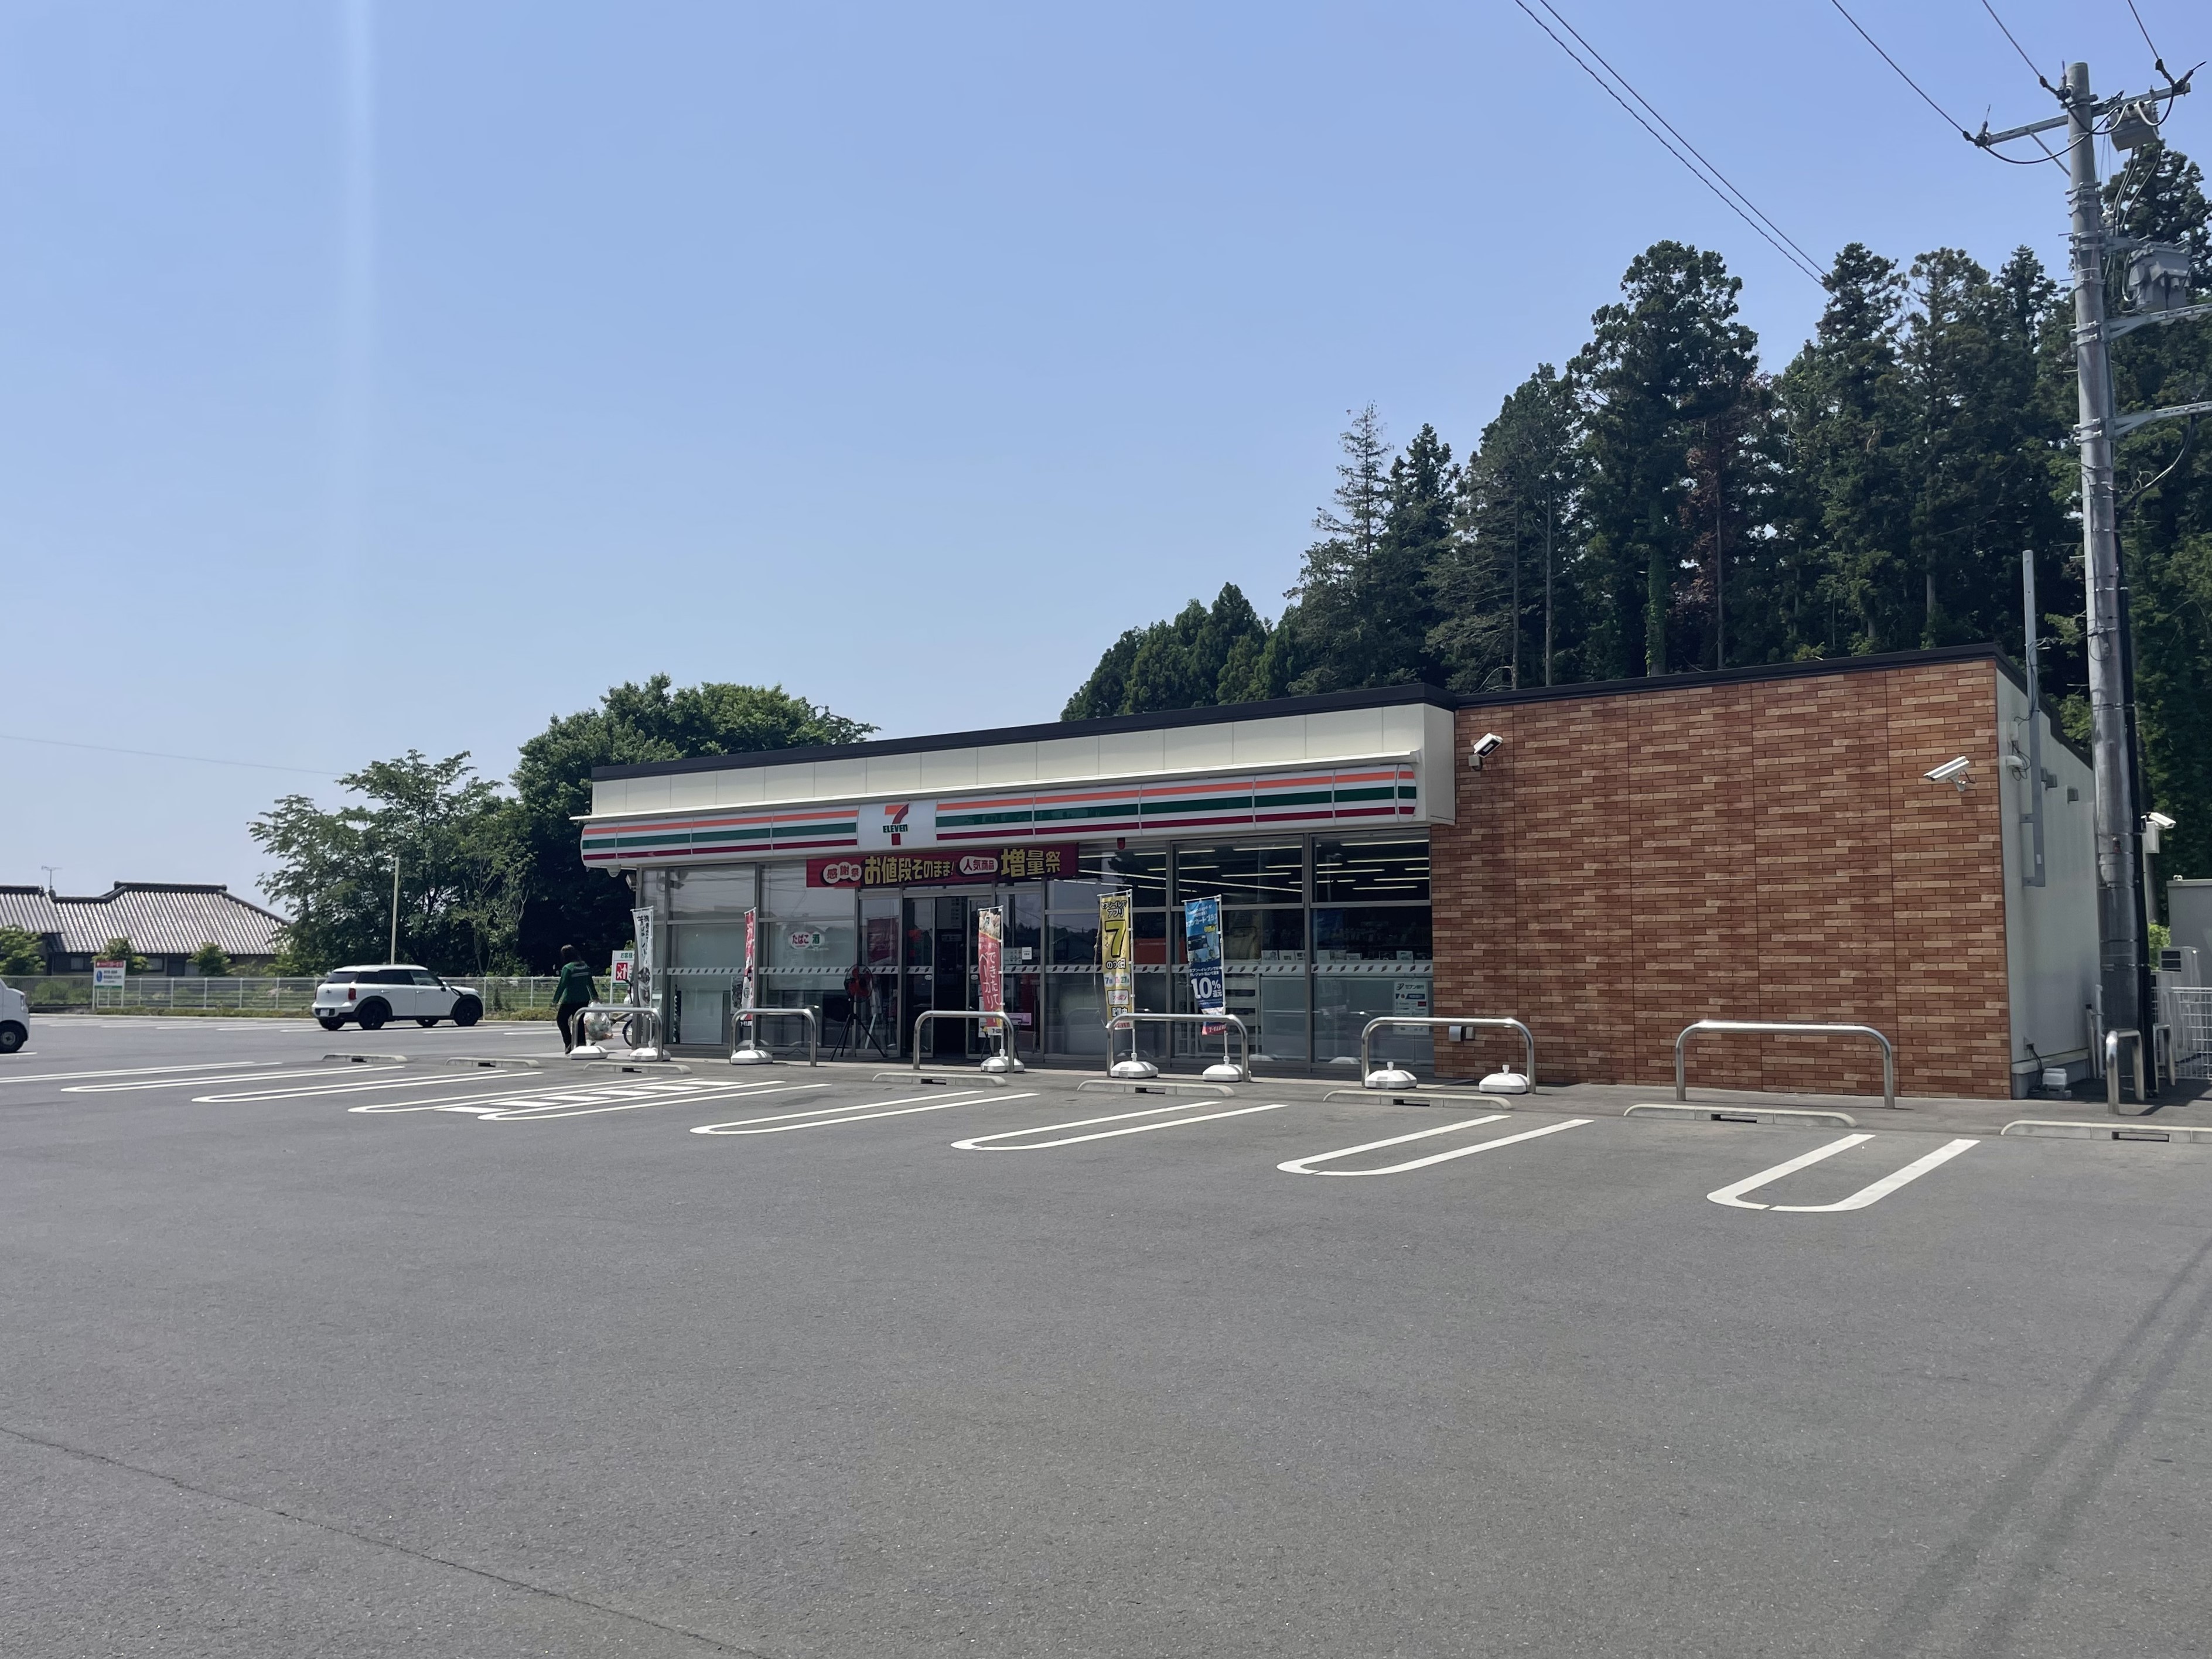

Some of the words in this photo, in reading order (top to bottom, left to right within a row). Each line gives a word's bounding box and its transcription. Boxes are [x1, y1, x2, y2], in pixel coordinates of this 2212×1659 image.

[885, 804, 909, 845] 7
[827, 864, 859, 881] 感謝祭
[964, 858, 995, 872] 人気商品
[1001, 848, 1060, 878] 増量祭
[792, 934, 809, 944] たばこ
[813, 934, 820, 944] 酒
[1105, 919, 1126, 958] 7
[988, 952, 1001, 1005] できたて
